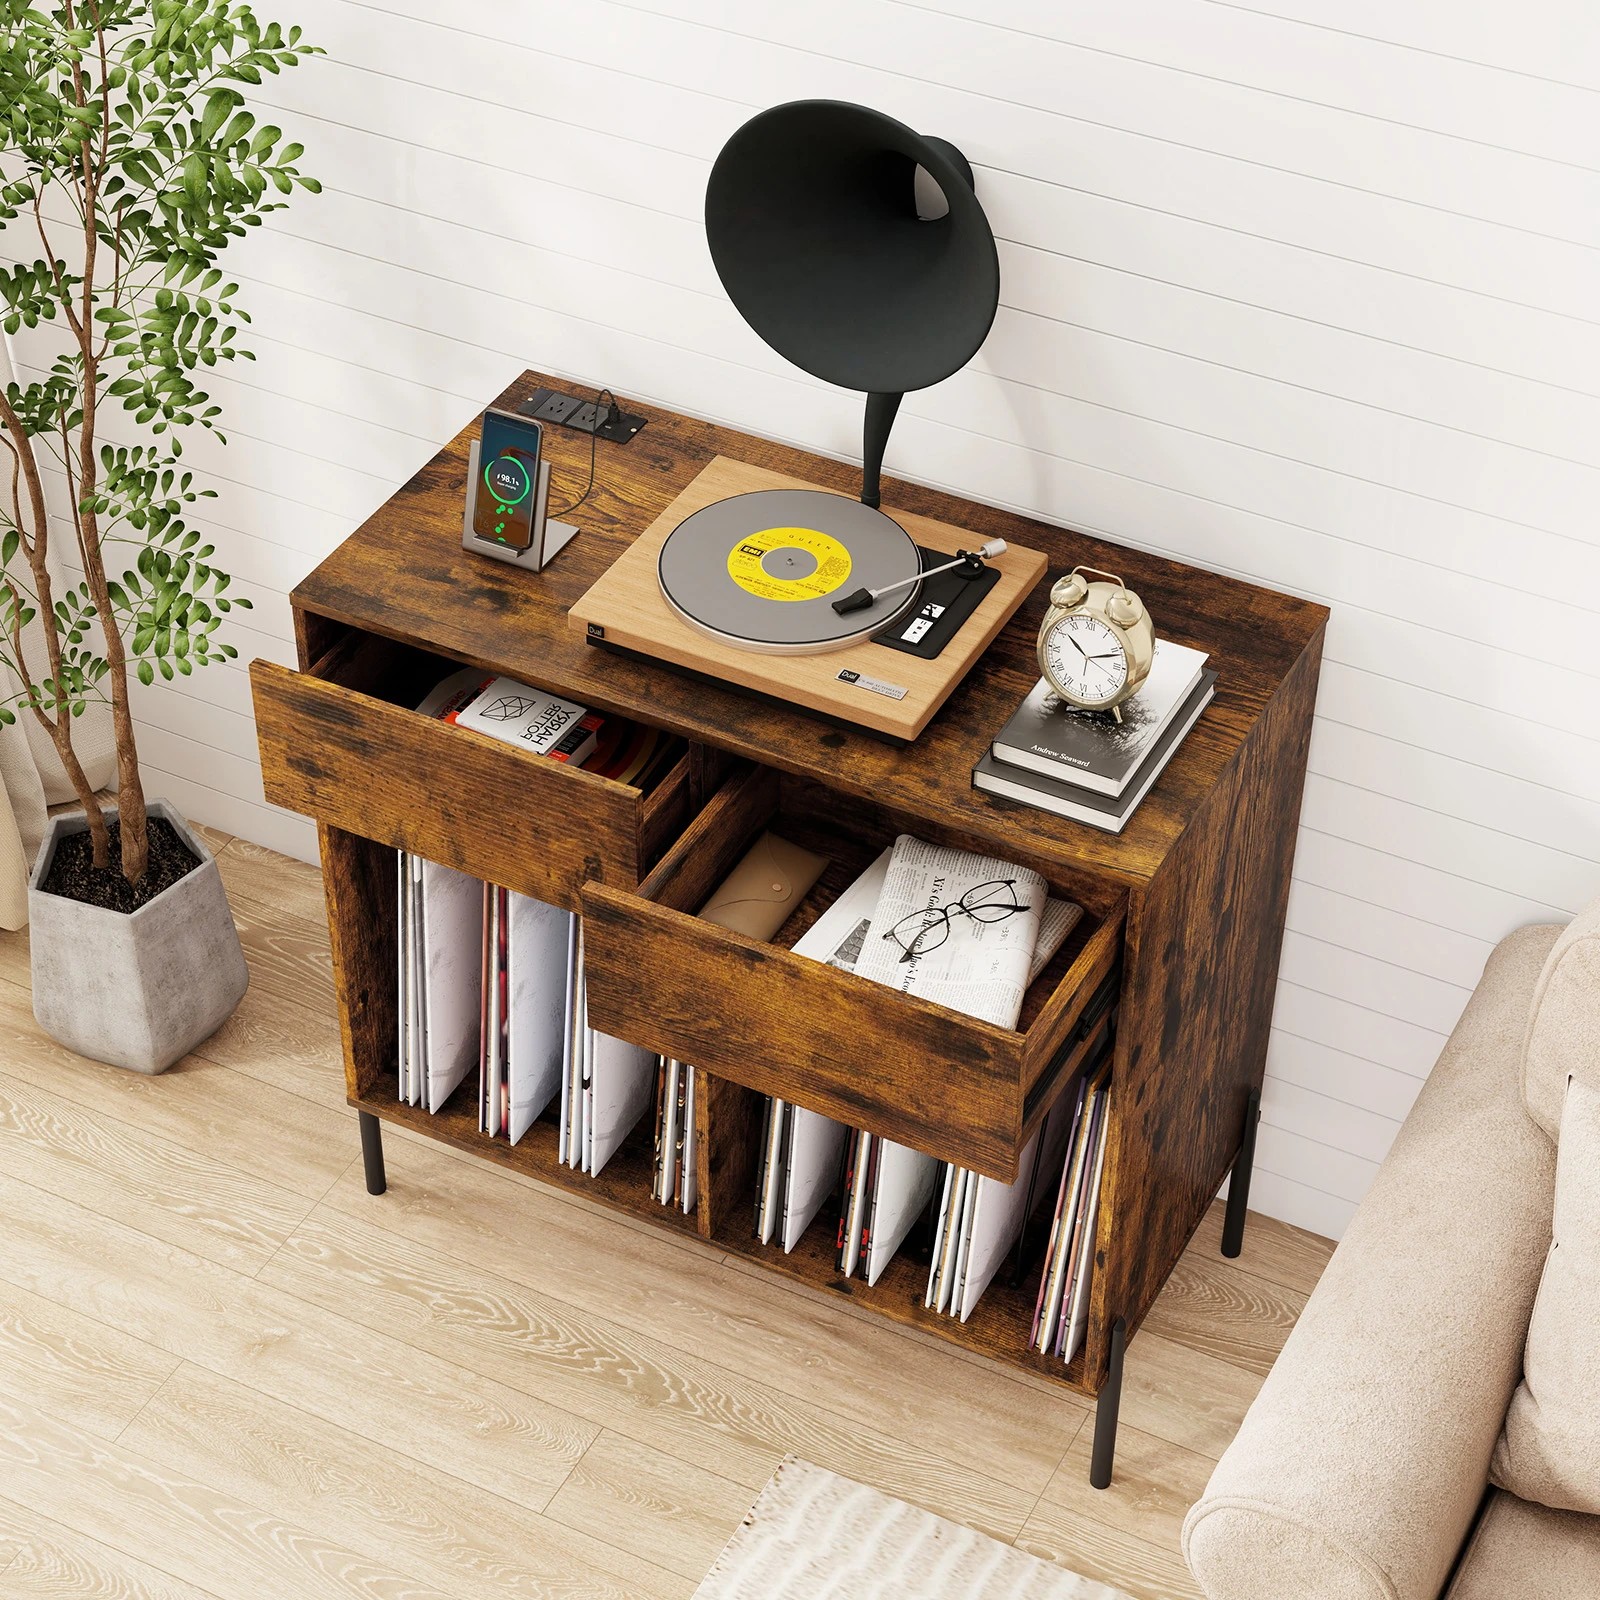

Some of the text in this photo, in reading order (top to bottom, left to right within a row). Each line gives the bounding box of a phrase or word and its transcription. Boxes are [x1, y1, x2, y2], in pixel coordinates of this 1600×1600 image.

[788, 534, 831, 550] QUEEN
[743, 546, 762, 556] EMI
[841, 670, 858, 680] Dual
[1031, 744, 1091, 767] Andrew Seaward
